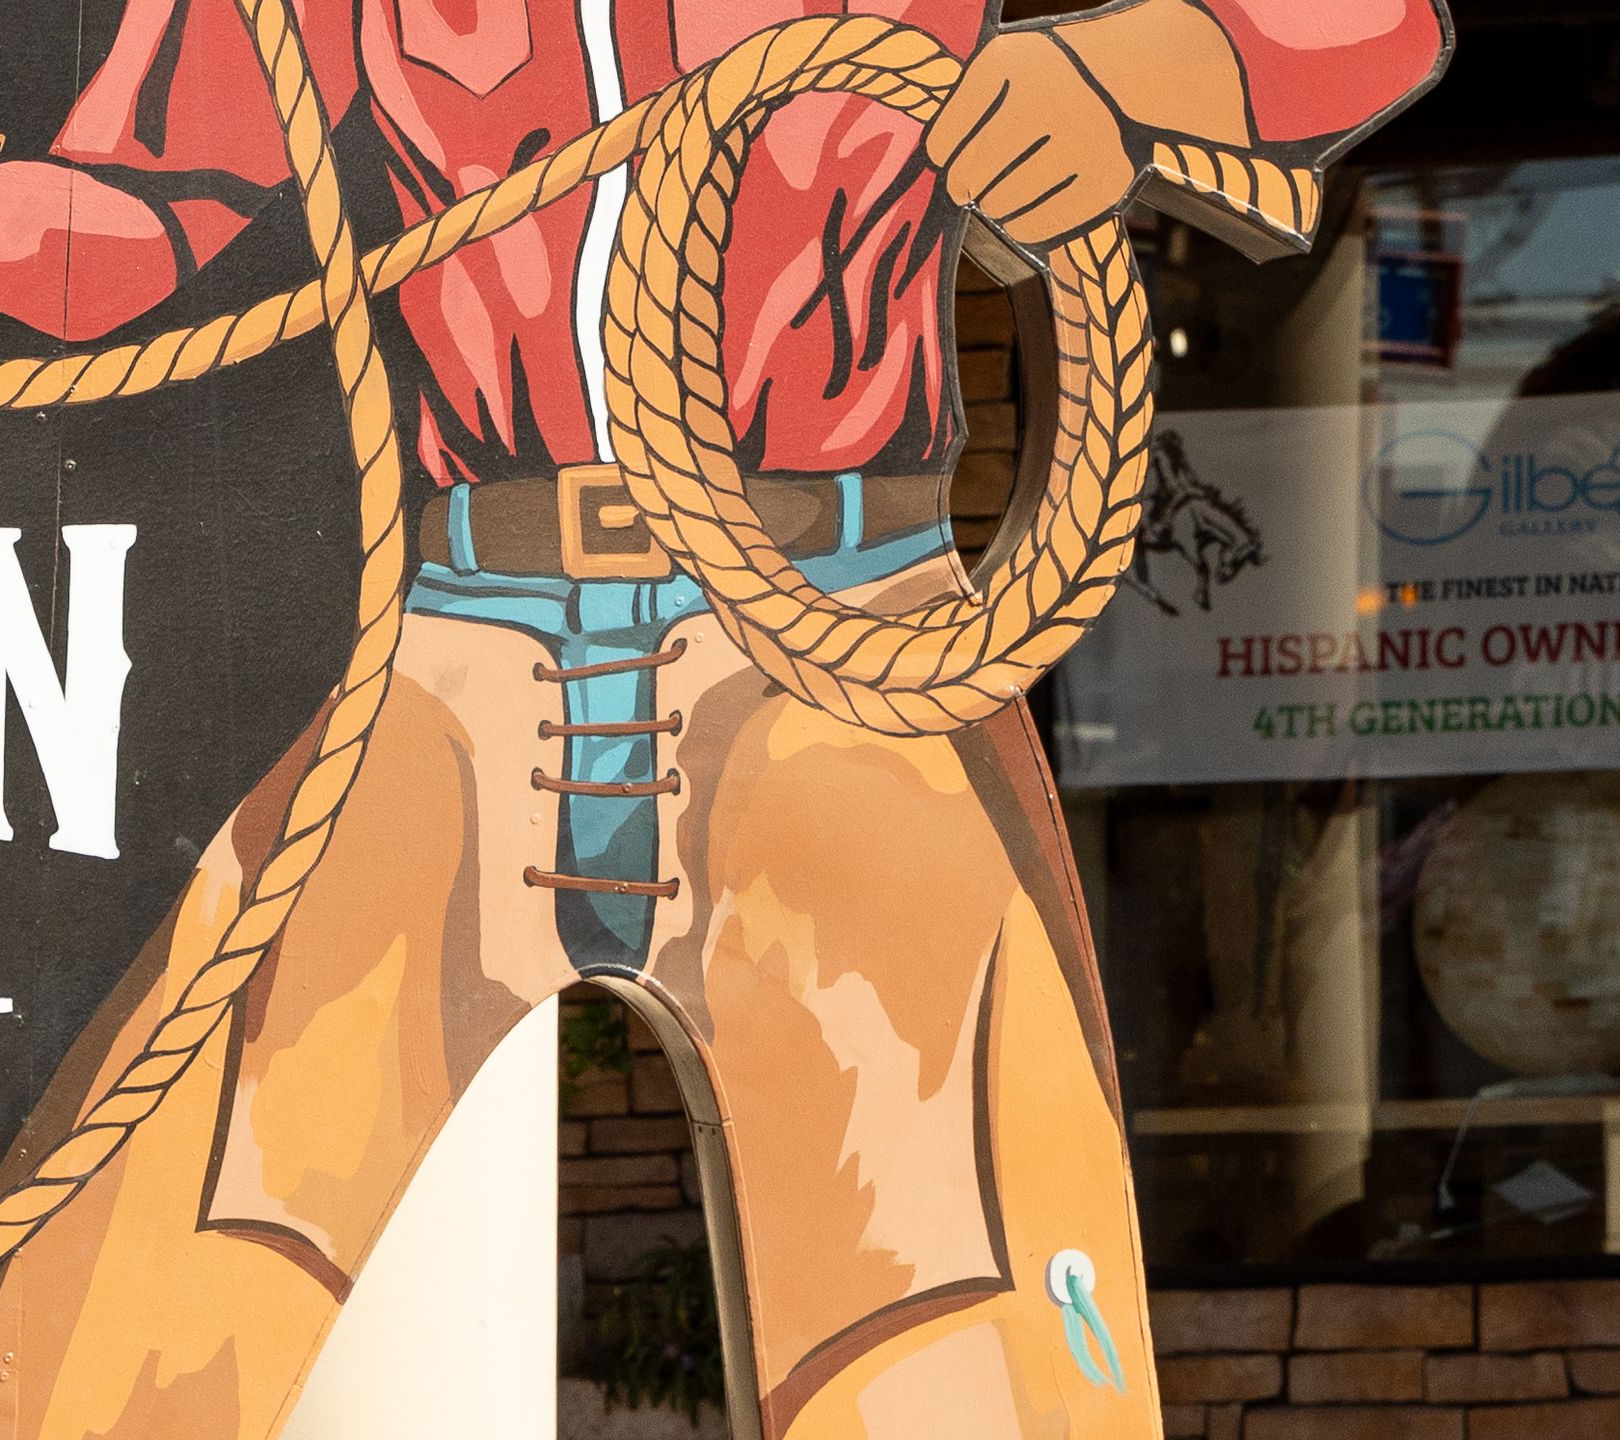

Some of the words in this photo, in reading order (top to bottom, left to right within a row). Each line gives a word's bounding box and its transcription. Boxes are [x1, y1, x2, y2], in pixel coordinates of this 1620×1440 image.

[1440, 575, 1530, 602] FINEST
[1534, 572, 1563, 596] IN
[1215, 624, 1467, 679] HISPANIC
[1252, 701, 1338, 741] 4TH
